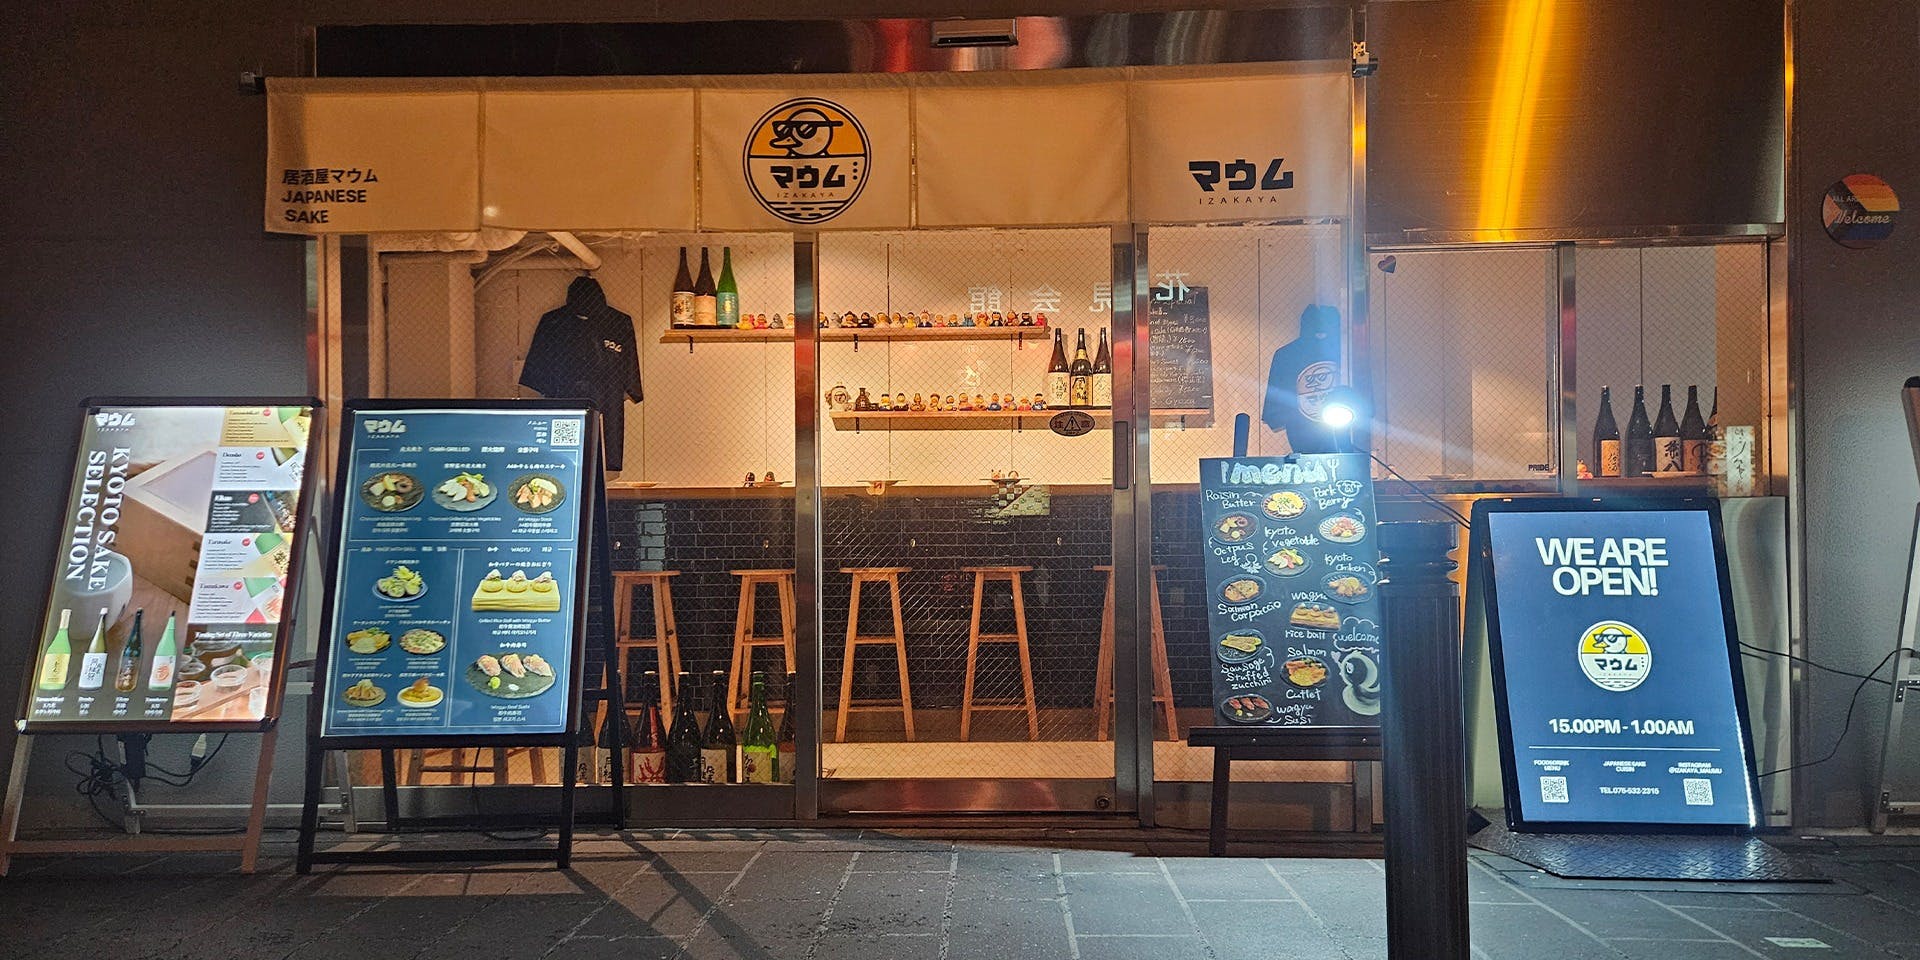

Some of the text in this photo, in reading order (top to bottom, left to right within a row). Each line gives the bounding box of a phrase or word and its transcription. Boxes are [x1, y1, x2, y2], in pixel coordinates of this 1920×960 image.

[282, 168, 378, 185] 居酒屋マウム
[770, 165, 845, 189] マウム
[1189, 158, 1294, 192] マウム
[282, 189, 367, 204] JAPANESE
[1199, 195, 1277, 205] IZAKAYA
[285, 209, 329, 224] SAKE
[364, 419, 406, 433] マウム
[1528, 464, 1550, 472] PRIDE
[101, 447, 131, 528] KYOTO
[1313, 485, 1337, 498] Pork
[65, 450, 107, 581] SELECTION
[88, 530, 116, 591] SAKE
[1536, 538, 1669, 567] WE ARE
[1552, 567, 1660, 597] OPEN!
[1594, 658, 1638, 671] マウム
[1549, 719, 1621, 735] 15.00PM
[1631, 719, 1694, 736] 1.00AM
